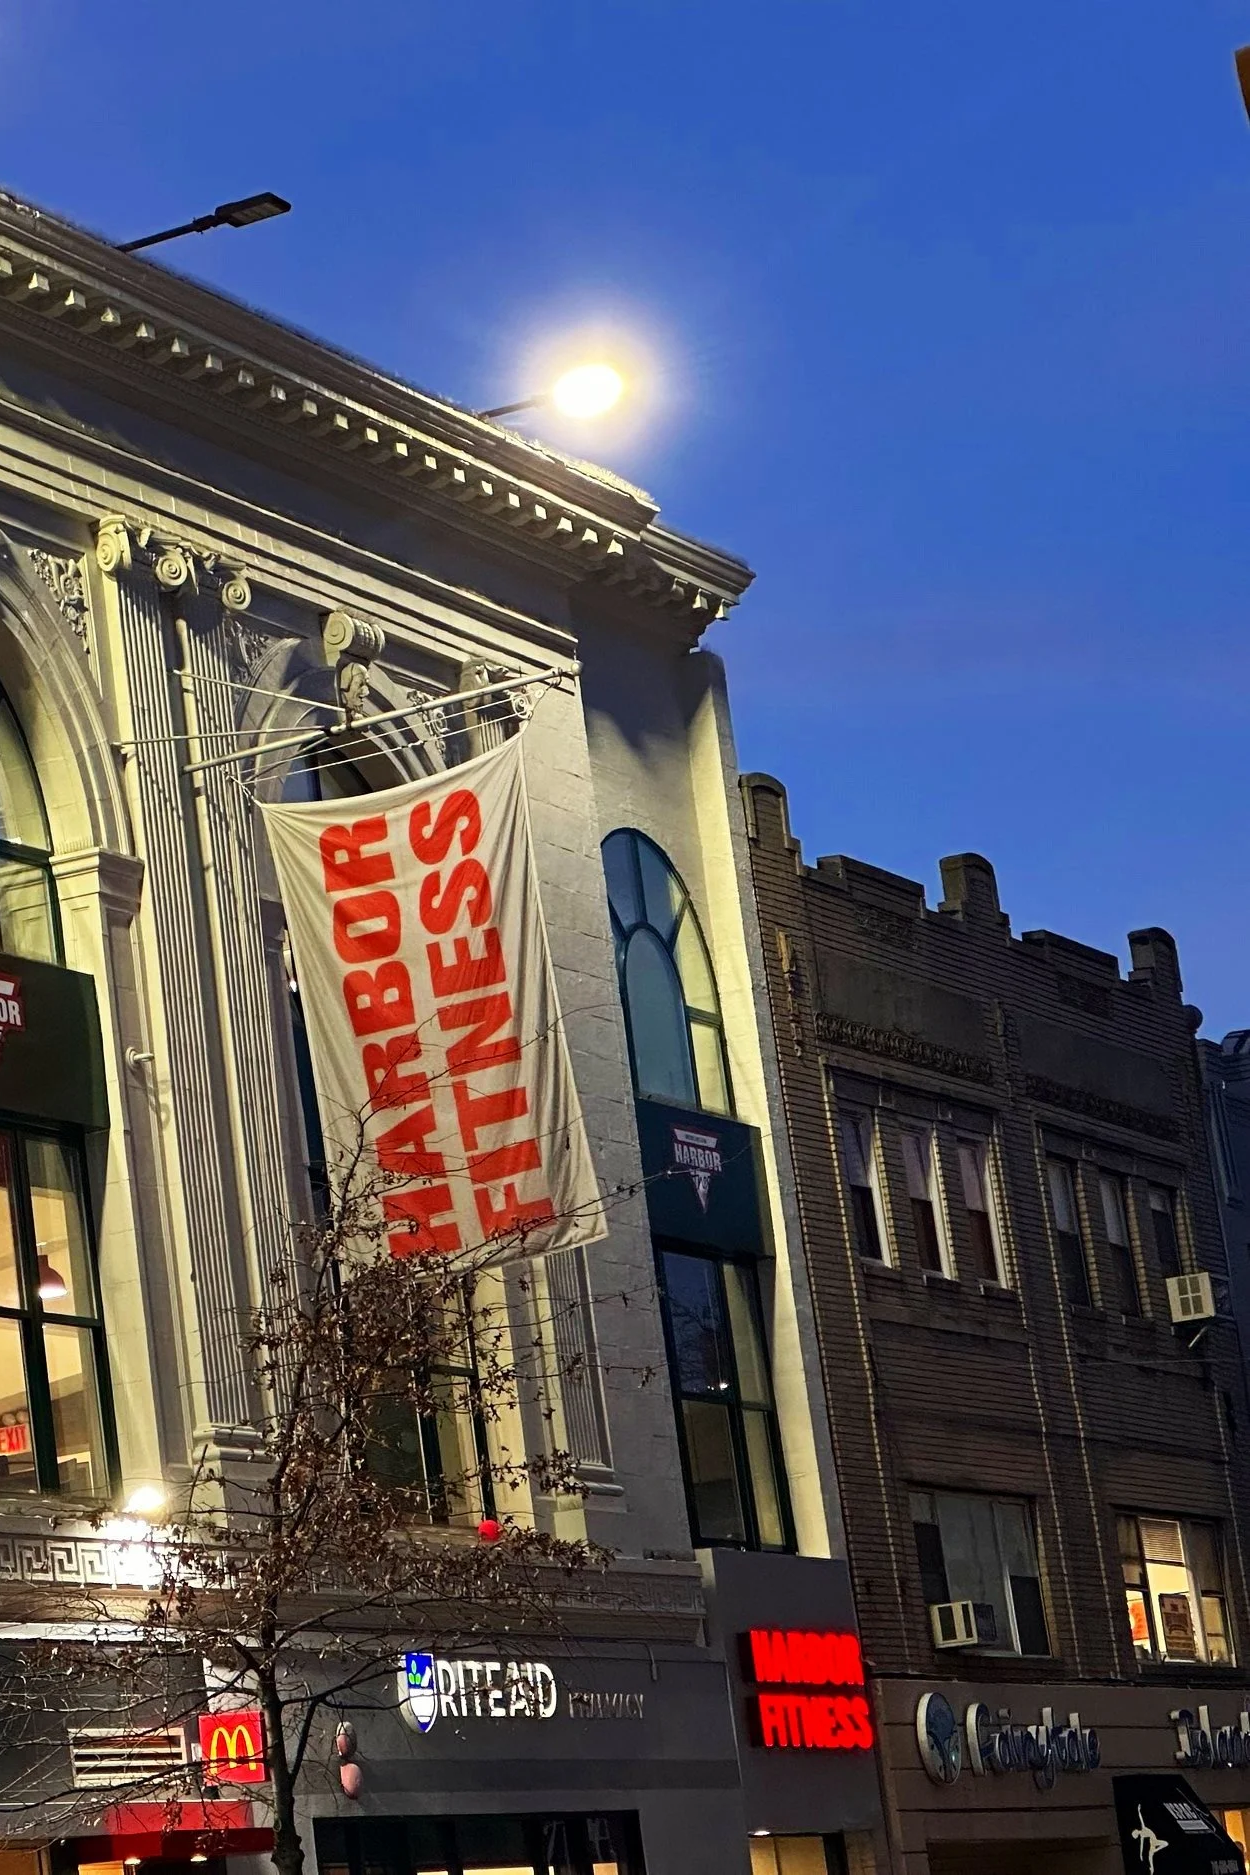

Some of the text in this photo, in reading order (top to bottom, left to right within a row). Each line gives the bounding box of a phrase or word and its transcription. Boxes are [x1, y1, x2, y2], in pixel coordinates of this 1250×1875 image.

[318, 811, 462, 1260] HARBOR
[408, 788, 557, 1241] FITNESS
[673, 1142, 723, 1173] HARBOR
[759, 1694, 873, 1749] FITNESS
